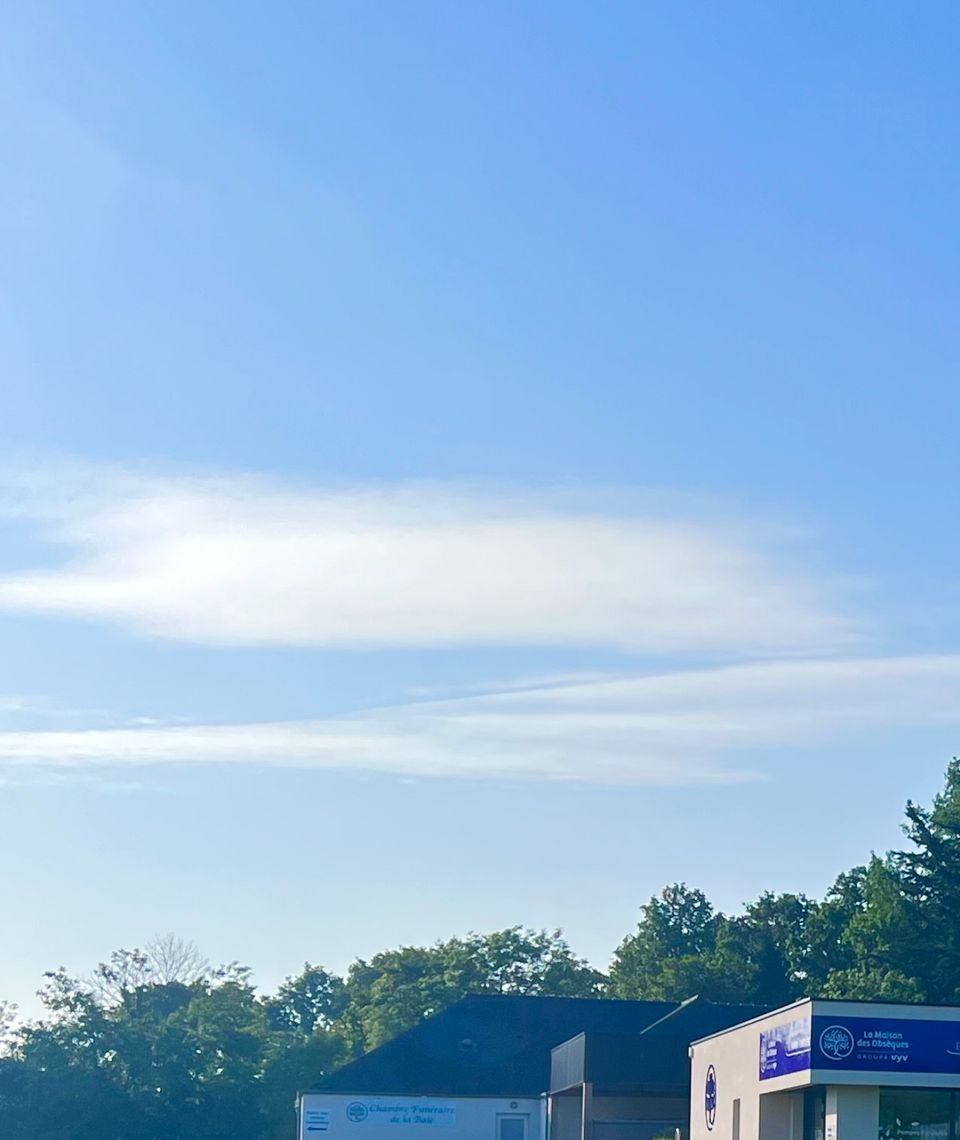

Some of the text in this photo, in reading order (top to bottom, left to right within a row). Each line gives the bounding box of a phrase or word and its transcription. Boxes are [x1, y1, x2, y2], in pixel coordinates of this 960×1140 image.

[863, 1031, 903, 1039] La Maison
[857, 1038, 909, 1050] des Obsèques
[891, 1055, 908, 1063] vyv
